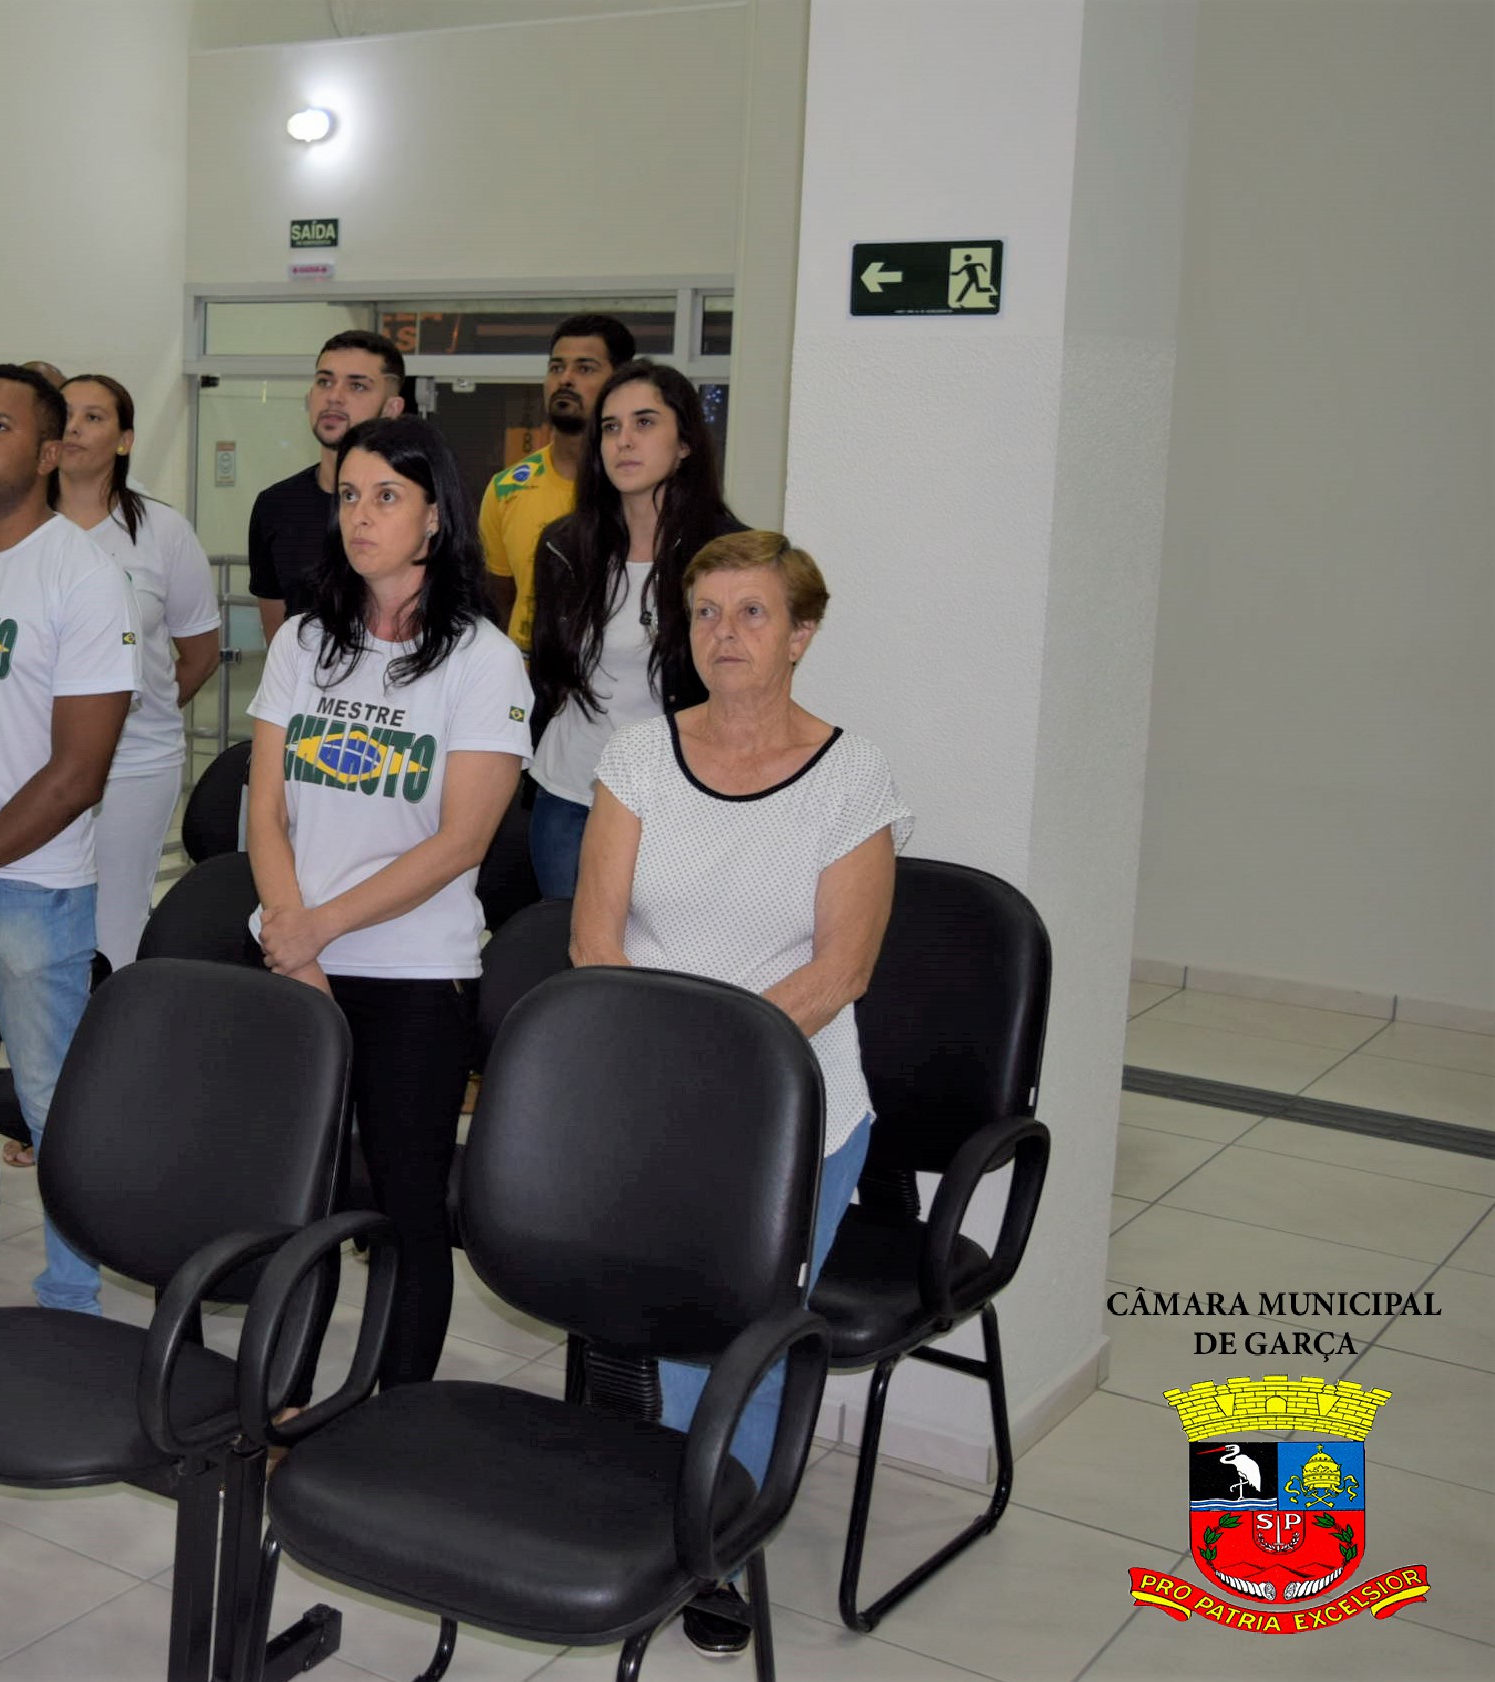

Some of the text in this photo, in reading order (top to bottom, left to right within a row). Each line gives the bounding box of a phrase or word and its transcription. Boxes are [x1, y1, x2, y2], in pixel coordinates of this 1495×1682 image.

[291, 220, 336, 240] SAÍDA
[316, 696, 406, 727] MESTRE
[284, 713, 437, 804] CHARUTO
